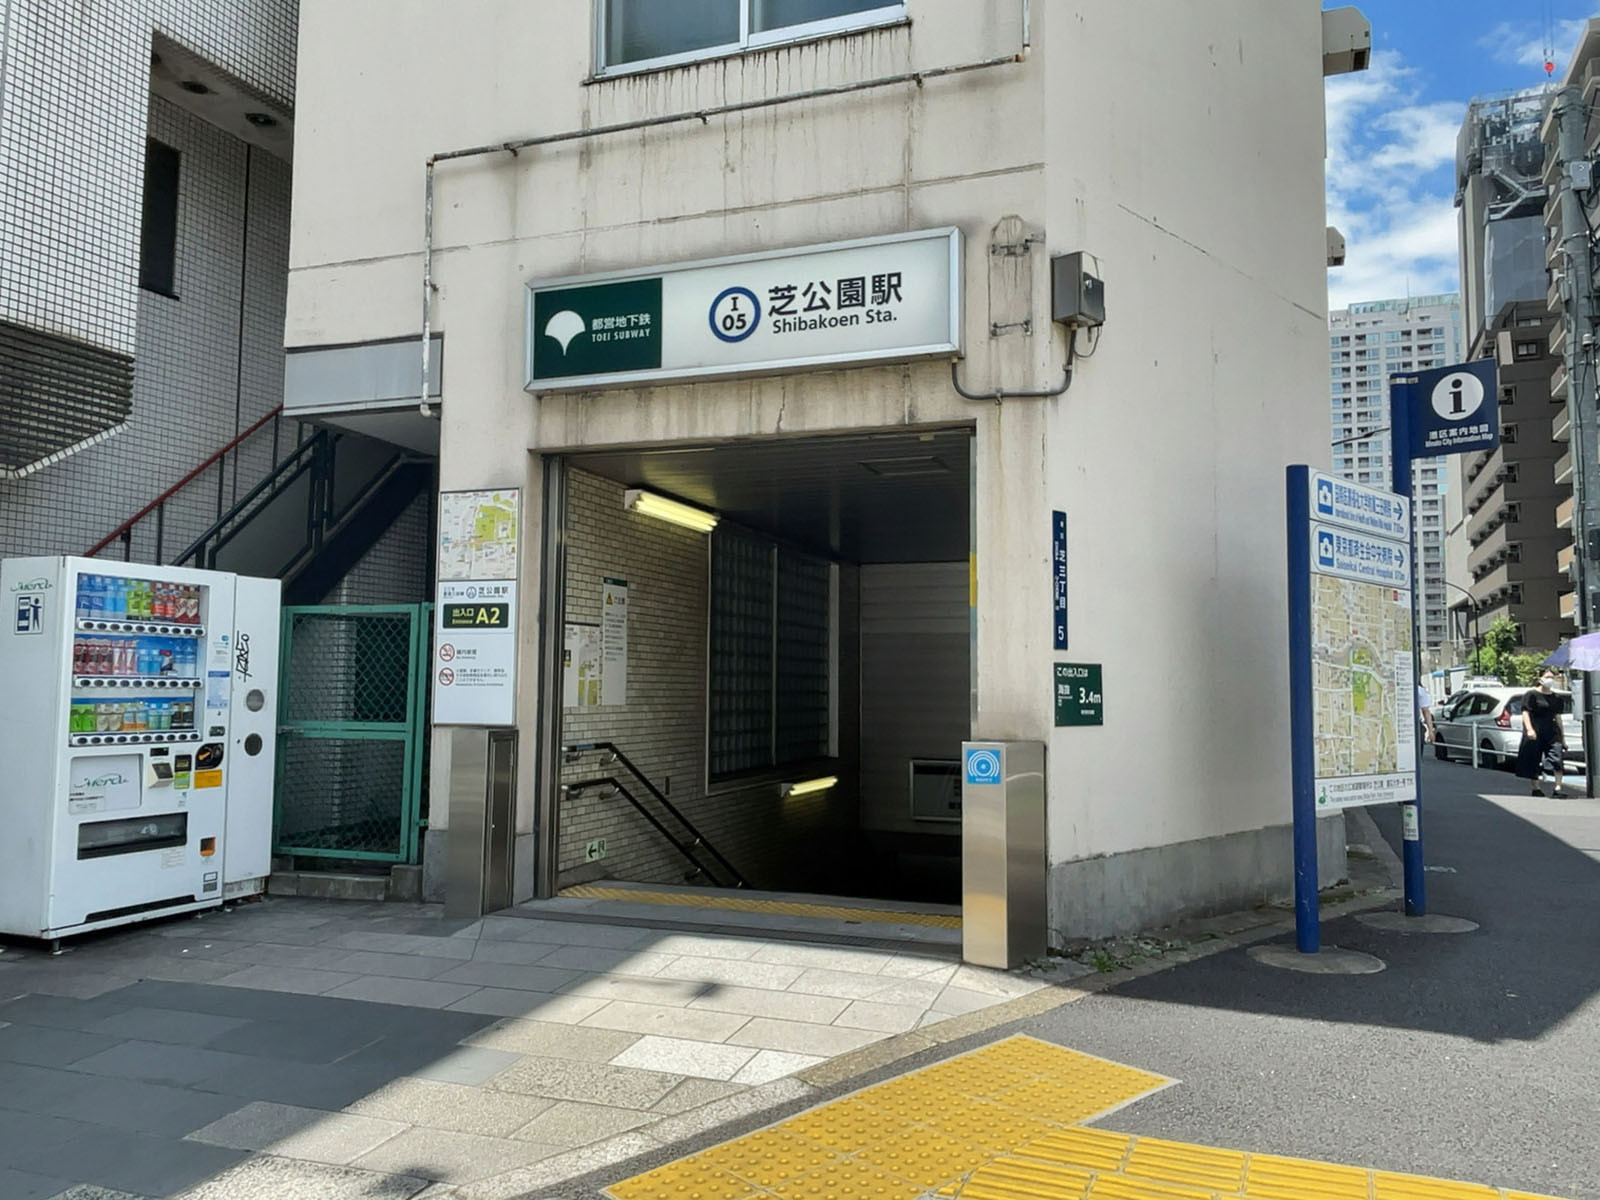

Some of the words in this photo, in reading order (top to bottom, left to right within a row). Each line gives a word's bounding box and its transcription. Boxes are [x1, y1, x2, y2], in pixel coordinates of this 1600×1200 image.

[768, 271, 903, 317] 芝公園駅
[730, 296, 739, 312] I
[591, 312, 651, 331] 都営地下鉄
[722, 313, 747, 332] 05
[772, 313, 860, 334] Shibakoen
[865, 308, 898, 325] Sta.
[591, 331, 611, 343] TOEI
[614, 328, 651, 341] SUBWAY
[452, 608, 474, 617] 出入口
[476, 607, 501, 625] A2
[1057, 624, 1065, 641] 5
[1078, 686, 1102, 704] 3.4m
